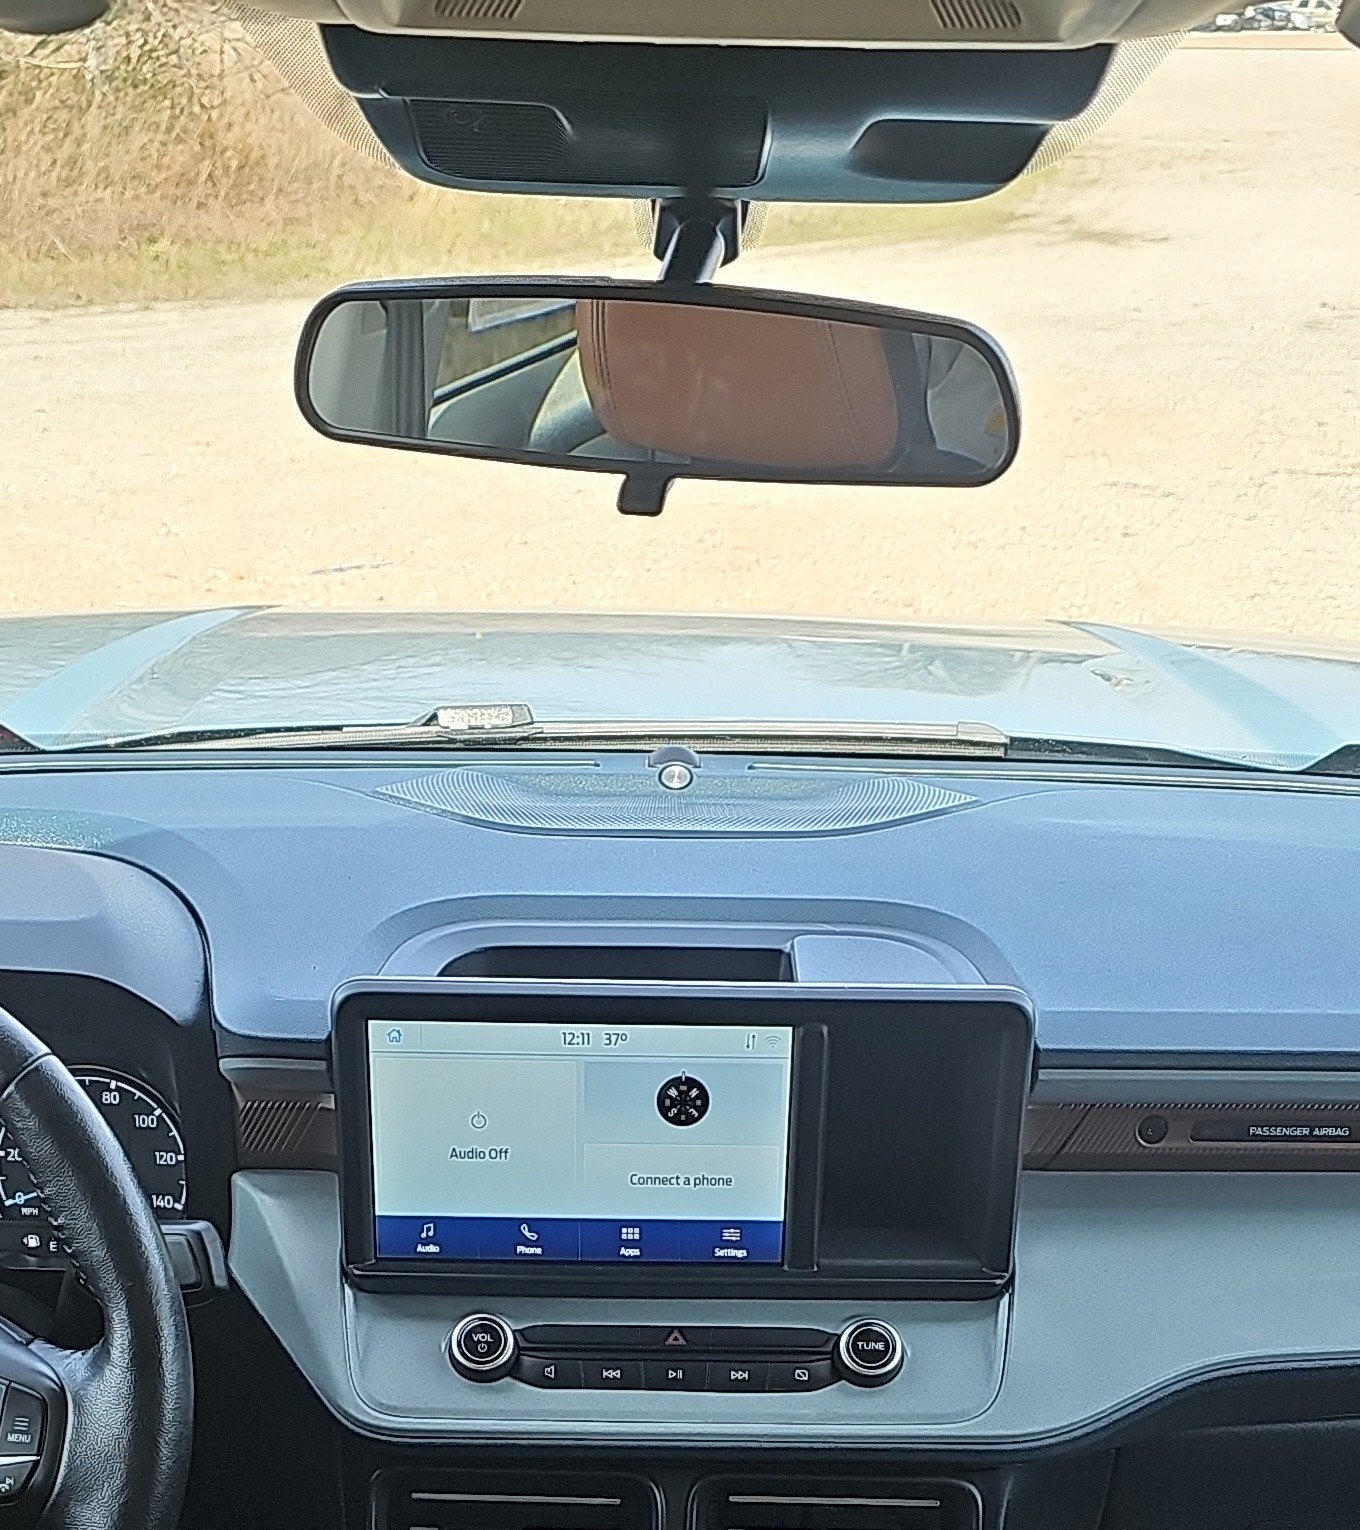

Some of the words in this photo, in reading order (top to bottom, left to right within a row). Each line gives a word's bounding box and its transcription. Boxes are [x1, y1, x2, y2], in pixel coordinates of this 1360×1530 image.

[561, 1031, 591, 1047] 12:11
[102, 1092, 120, 1104] 80
[134, 1115, 157, 1128] 100
[1249, 1126, 1309, 1136] PASSENGER
[1312, 1127, 1350, 1136] AIRBAG
[155, 1152, 176, 1165] 120
[449, 1147, 486, 1161] Audio
[488, 1147, 509, 1161] Off
[629, 1174, 681, 1187] Connect
[683, 1177, 691, 1187] a
[693, 1174, 733, 1190] phone
[152, 1195, 174, 1208] 140
[21, 1207, 38, 1216] MPH
[49, 1241, 58, 1251] E
[416, 1243, 440, 1254] Audio
[516, 1245, 542, 1255] Phone
[619, 1246, 640, 1257] Apps
[714, 1247, 748, 1258] Settings
[471, 1332, 494, 1343] VOL
[856, 1341, 886, 1351] TUNE
[6, 1432, 32, 1443] MENU
